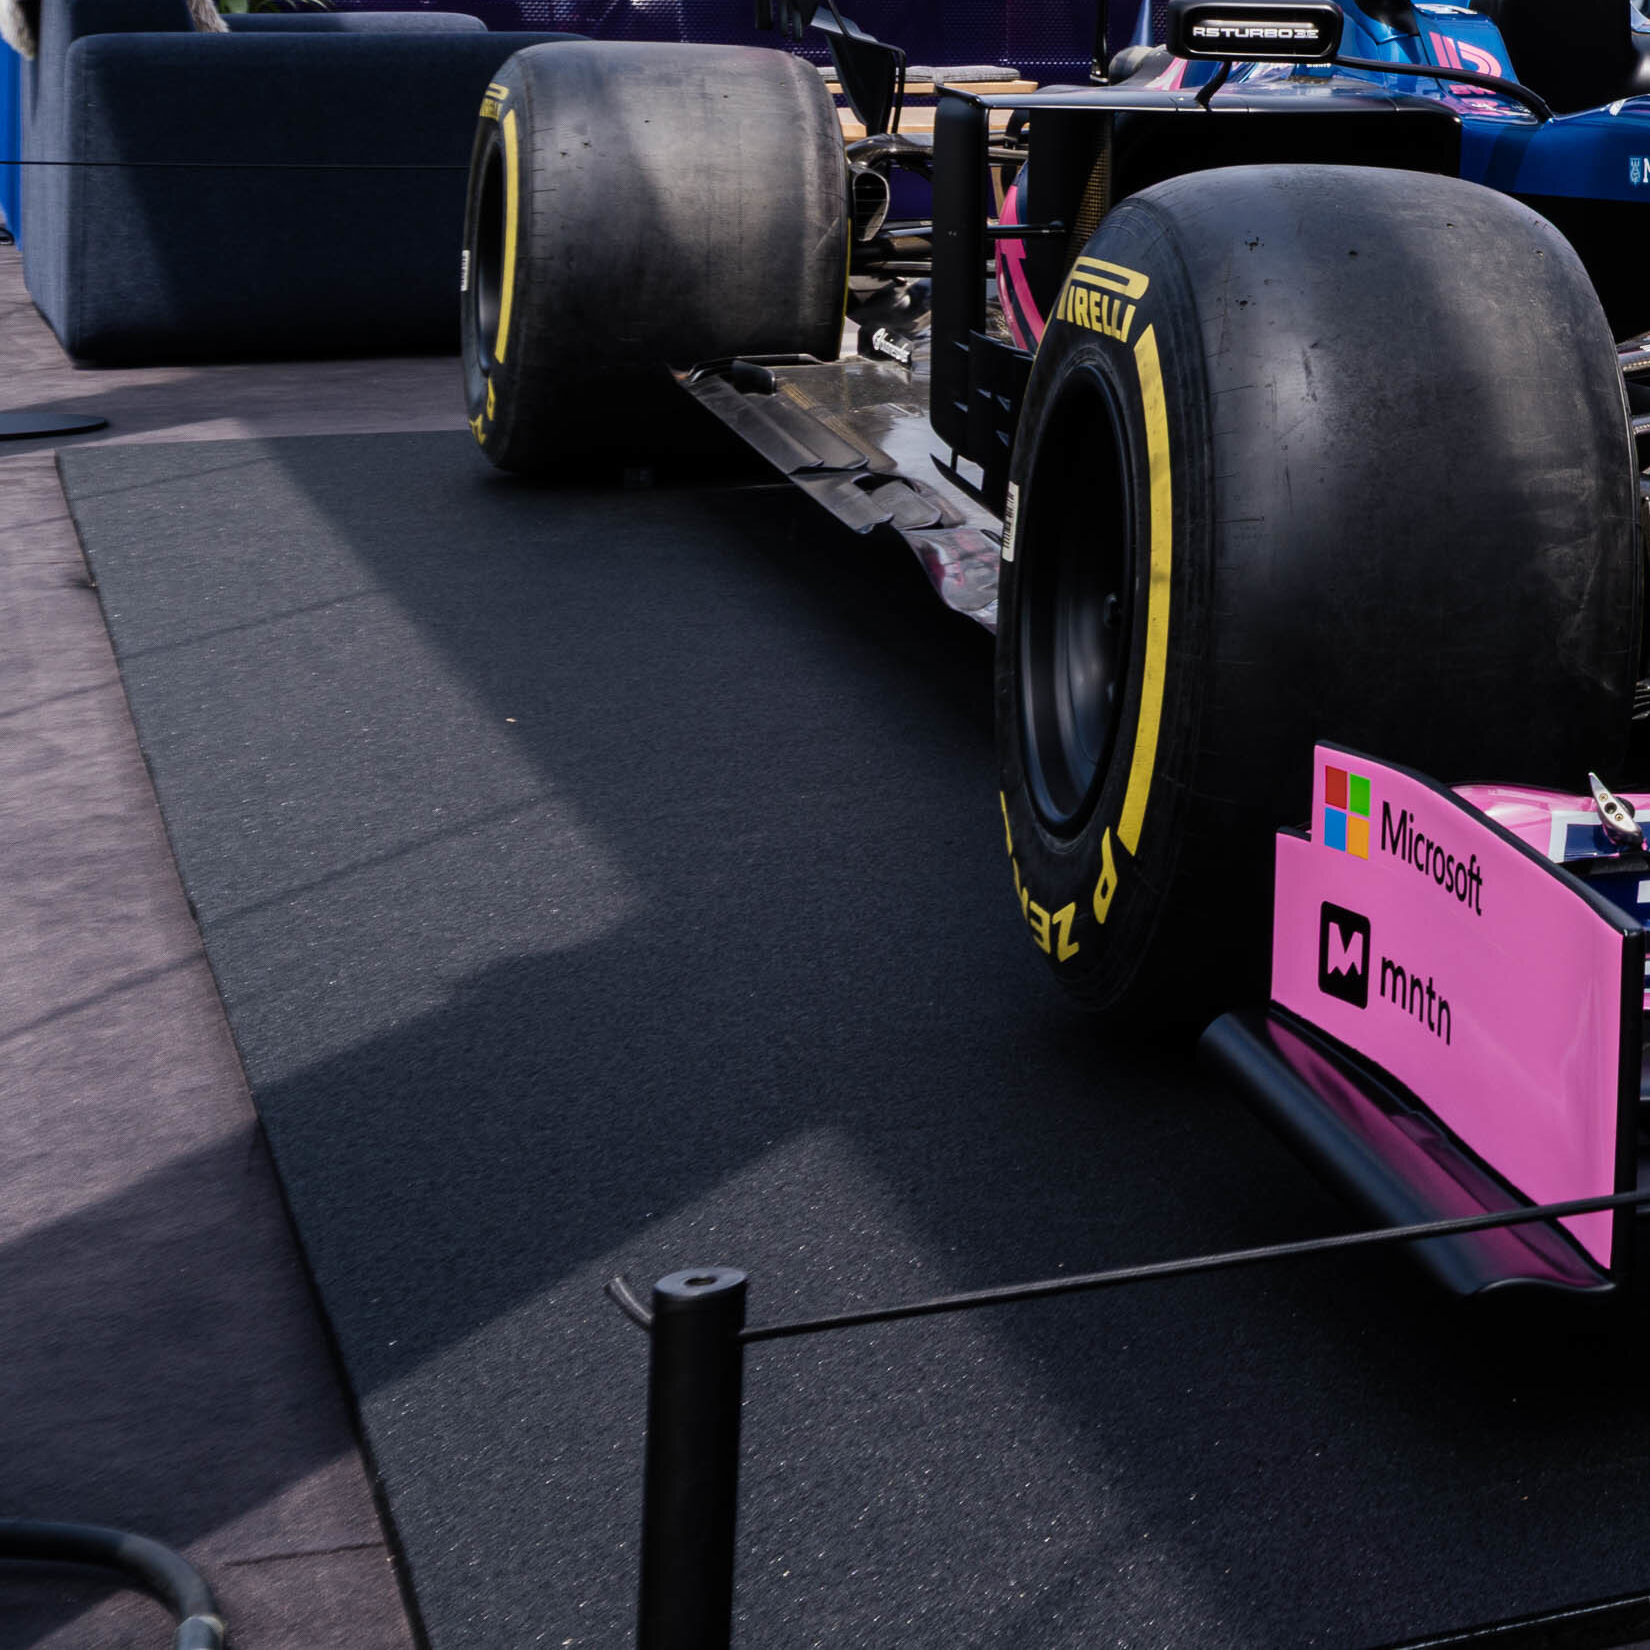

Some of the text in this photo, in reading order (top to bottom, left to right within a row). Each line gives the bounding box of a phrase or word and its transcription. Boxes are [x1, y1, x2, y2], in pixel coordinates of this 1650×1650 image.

[1056, 255, 1150, 343] PIRELLI
[1380, 800, 1483, 917] Microsoft
[1379, 956, 1451, 1046] mntn
